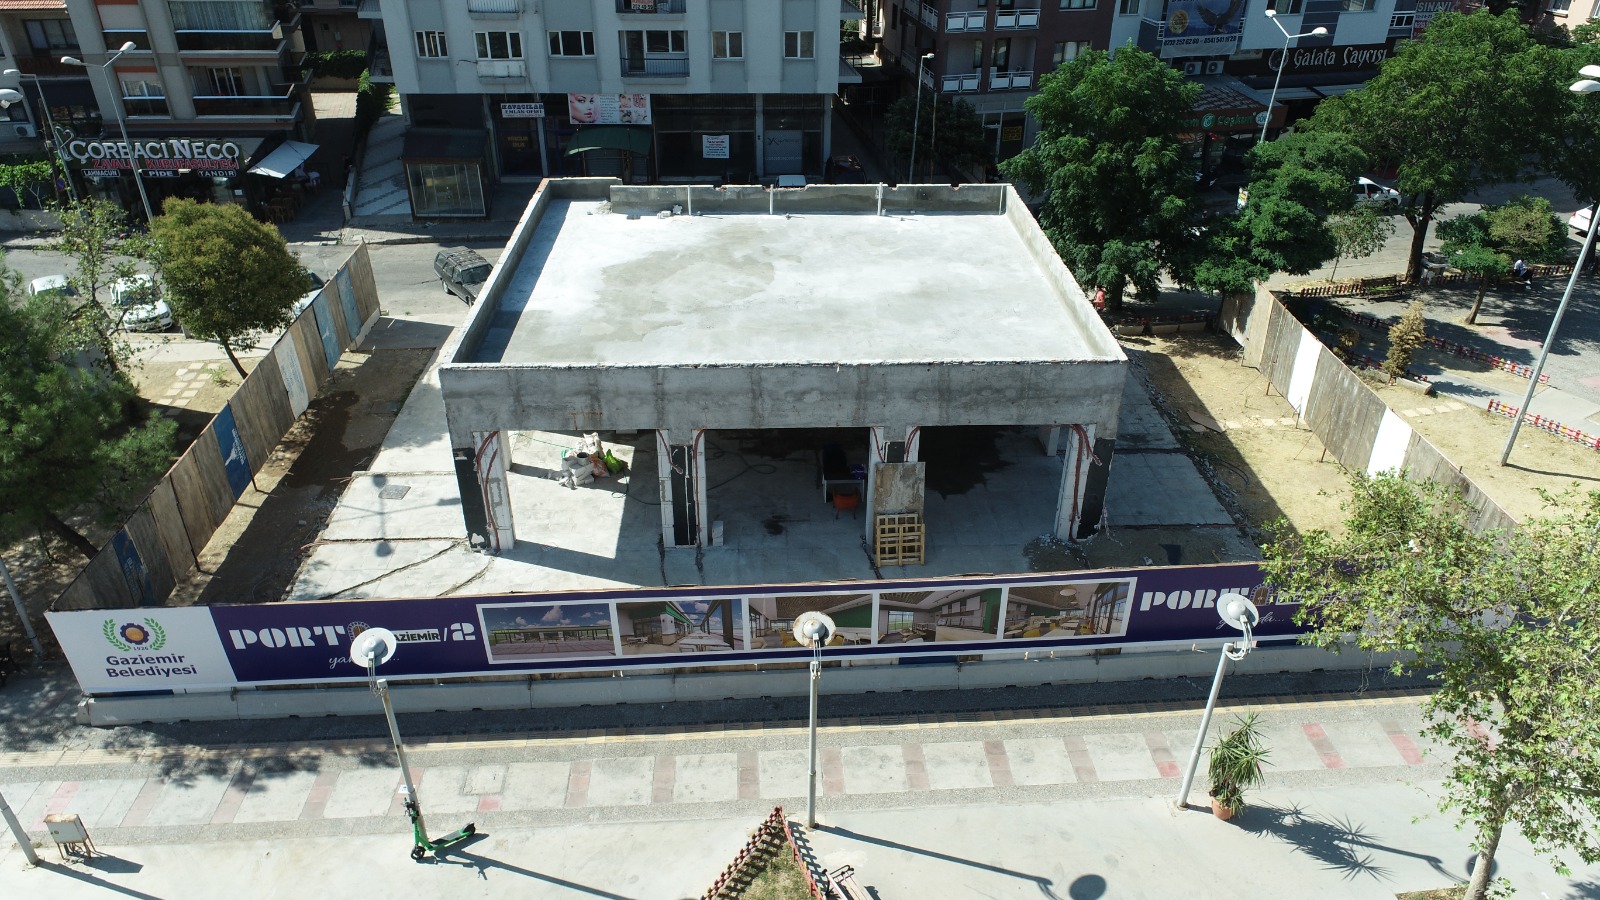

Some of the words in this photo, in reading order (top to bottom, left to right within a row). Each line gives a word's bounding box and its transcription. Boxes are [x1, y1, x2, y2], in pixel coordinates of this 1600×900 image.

[1293, 48, 1336, 69] Galata
[169, 139, 240, 160] NECO
[200, 169, 235, 177] TANDIR
[228, 625, 346, 650] PORT
[393, 631, 440, 642] AZİEMİR
[106, 653, 185, 666] Gaziemir
[105, 664, 198, 678] Belediyesi
